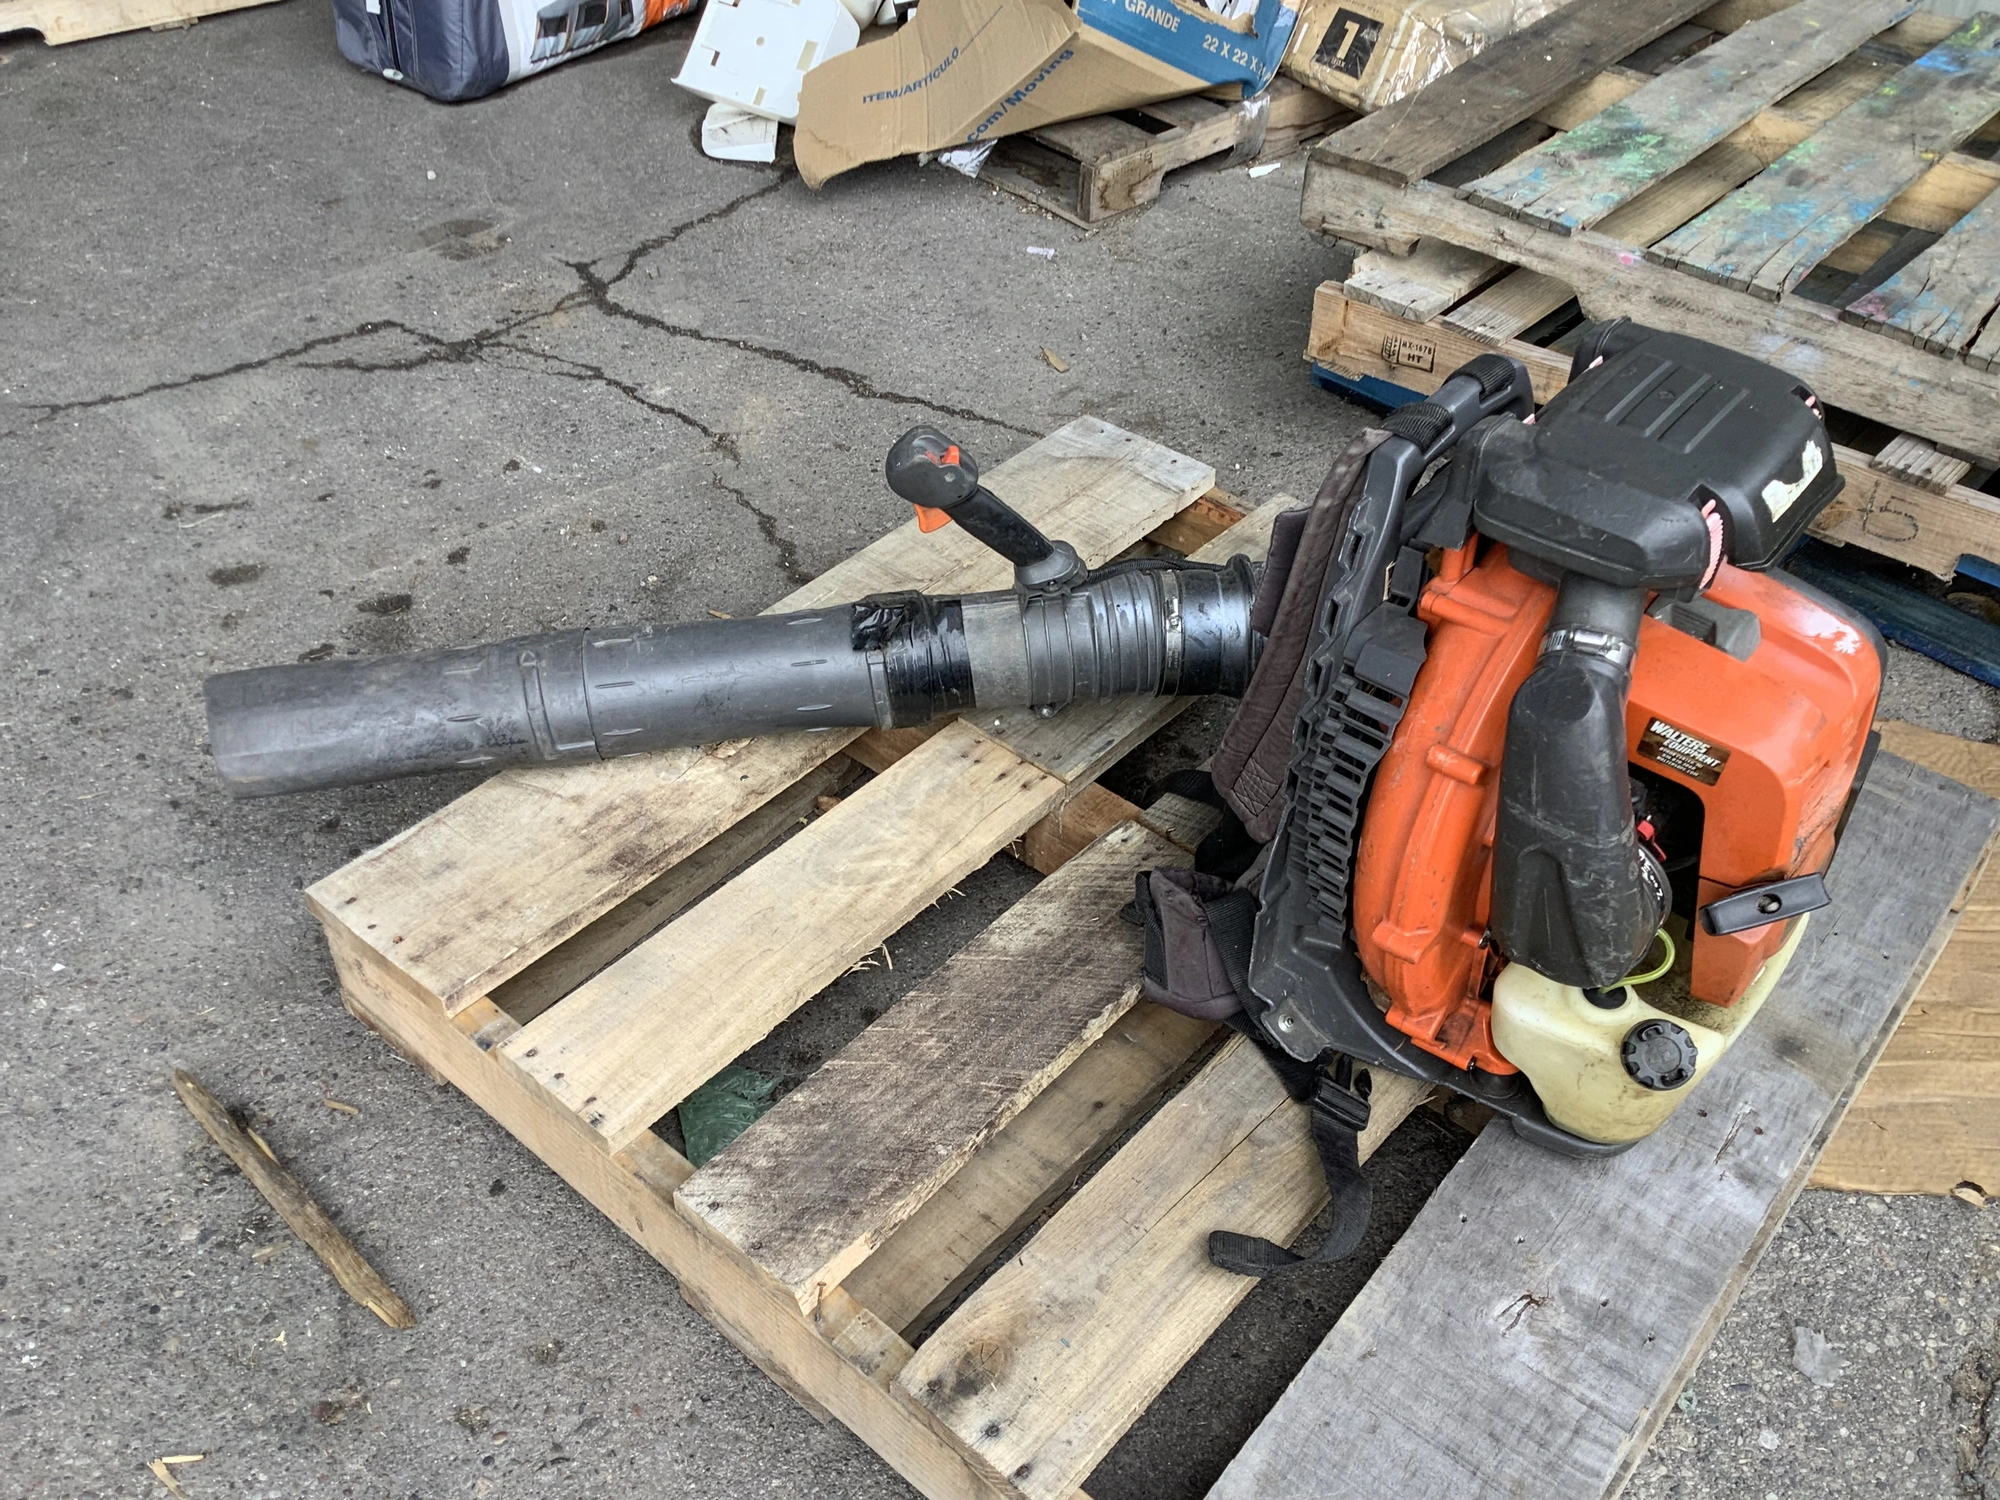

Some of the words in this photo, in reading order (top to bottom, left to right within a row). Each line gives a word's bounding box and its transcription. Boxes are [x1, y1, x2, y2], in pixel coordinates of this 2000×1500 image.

[1124, 0, 1180, 33] GRANDE
[1202, 34, 1219, 53] 22
[1220, 42, 1231, 59] X
[1232, 48, 1248, 67] 22
[1337, 20, 1360, 60] 1
[1407, 353, 1423, 364] HT
[1650, 720, 1711, 754] WALTERS
[1663, 739, 1721, 767] EQUIPMENT
